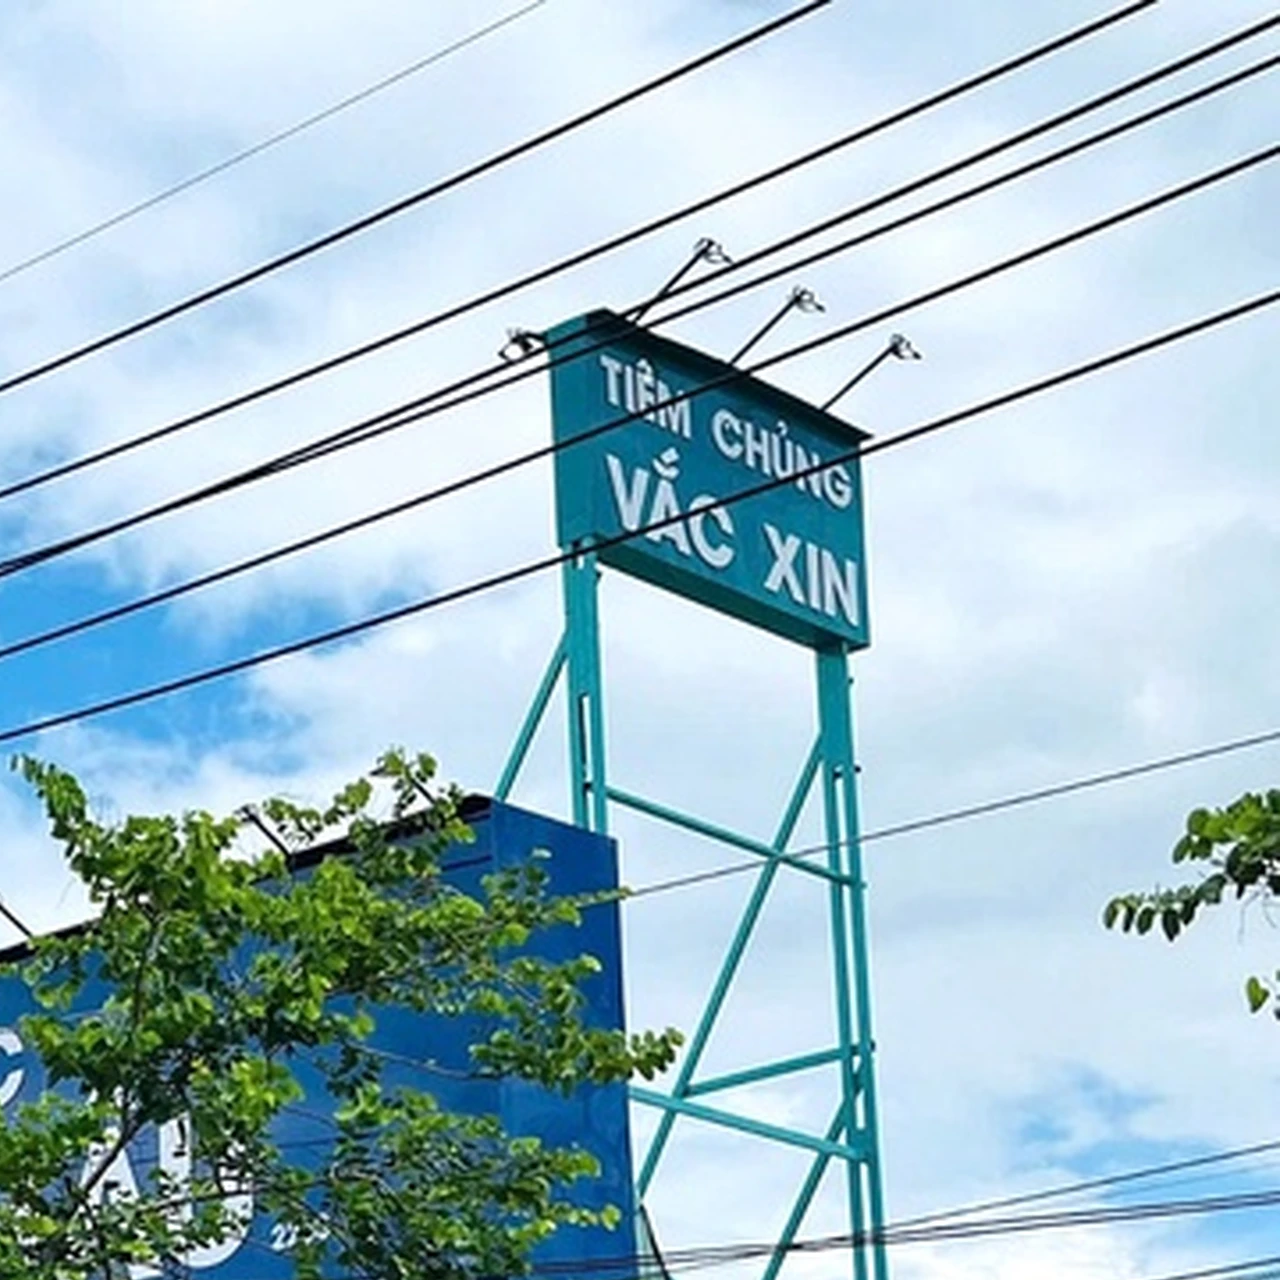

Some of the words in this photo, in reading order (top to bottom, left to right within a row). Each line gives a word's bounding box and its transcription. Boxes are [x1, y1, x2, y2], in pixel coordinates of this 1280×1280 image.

[599, 355, 691, 438] TIÊM
[712, 409, 852, 508] CHỦNG
[607, 447, 735, 568] VẮC
[763, 523, 858, 627] XIN
